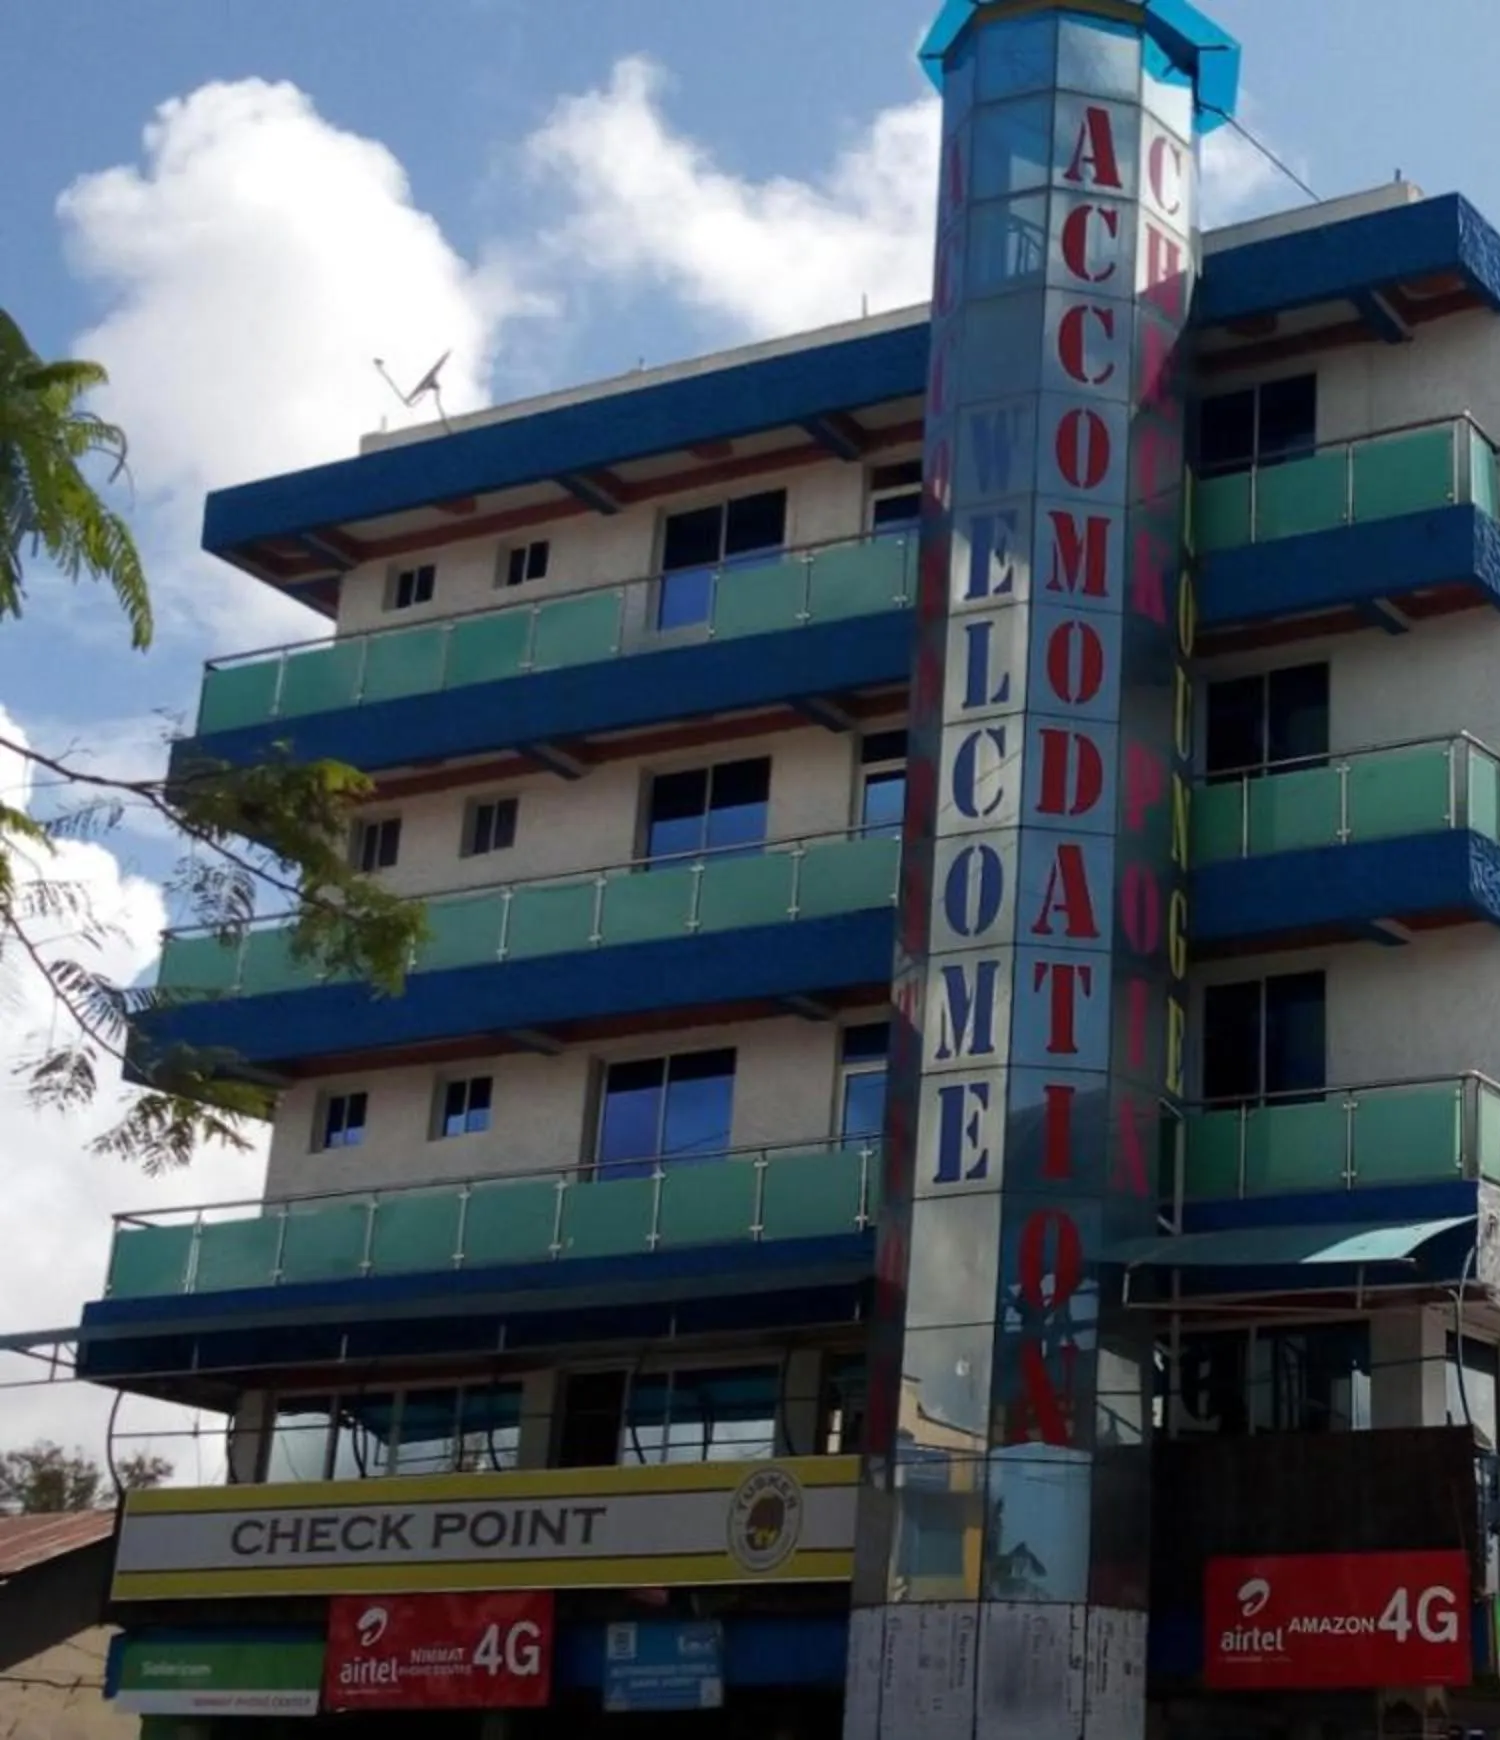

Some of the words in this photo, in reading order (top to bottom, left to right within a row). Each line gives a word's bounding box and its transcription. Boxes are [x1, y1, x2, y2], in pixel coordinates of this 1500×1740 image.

[931, 406, 1022, 1185] WELCOME
[1008, 106, 1124, 1447] ACCOMODATION
[231, 1513, 413, 1556] CHECK
[431, 1507, 607, 1549] POINT
[1220, 1625, 1284, 1651] airtel
[1288, 1616, 1375, 1635] AMAZON
[1378, 1586, 1458, 1643] 4G
[340, 1656, 398, 1684] airtel
[473, 1620, 541, 1676] 4G
